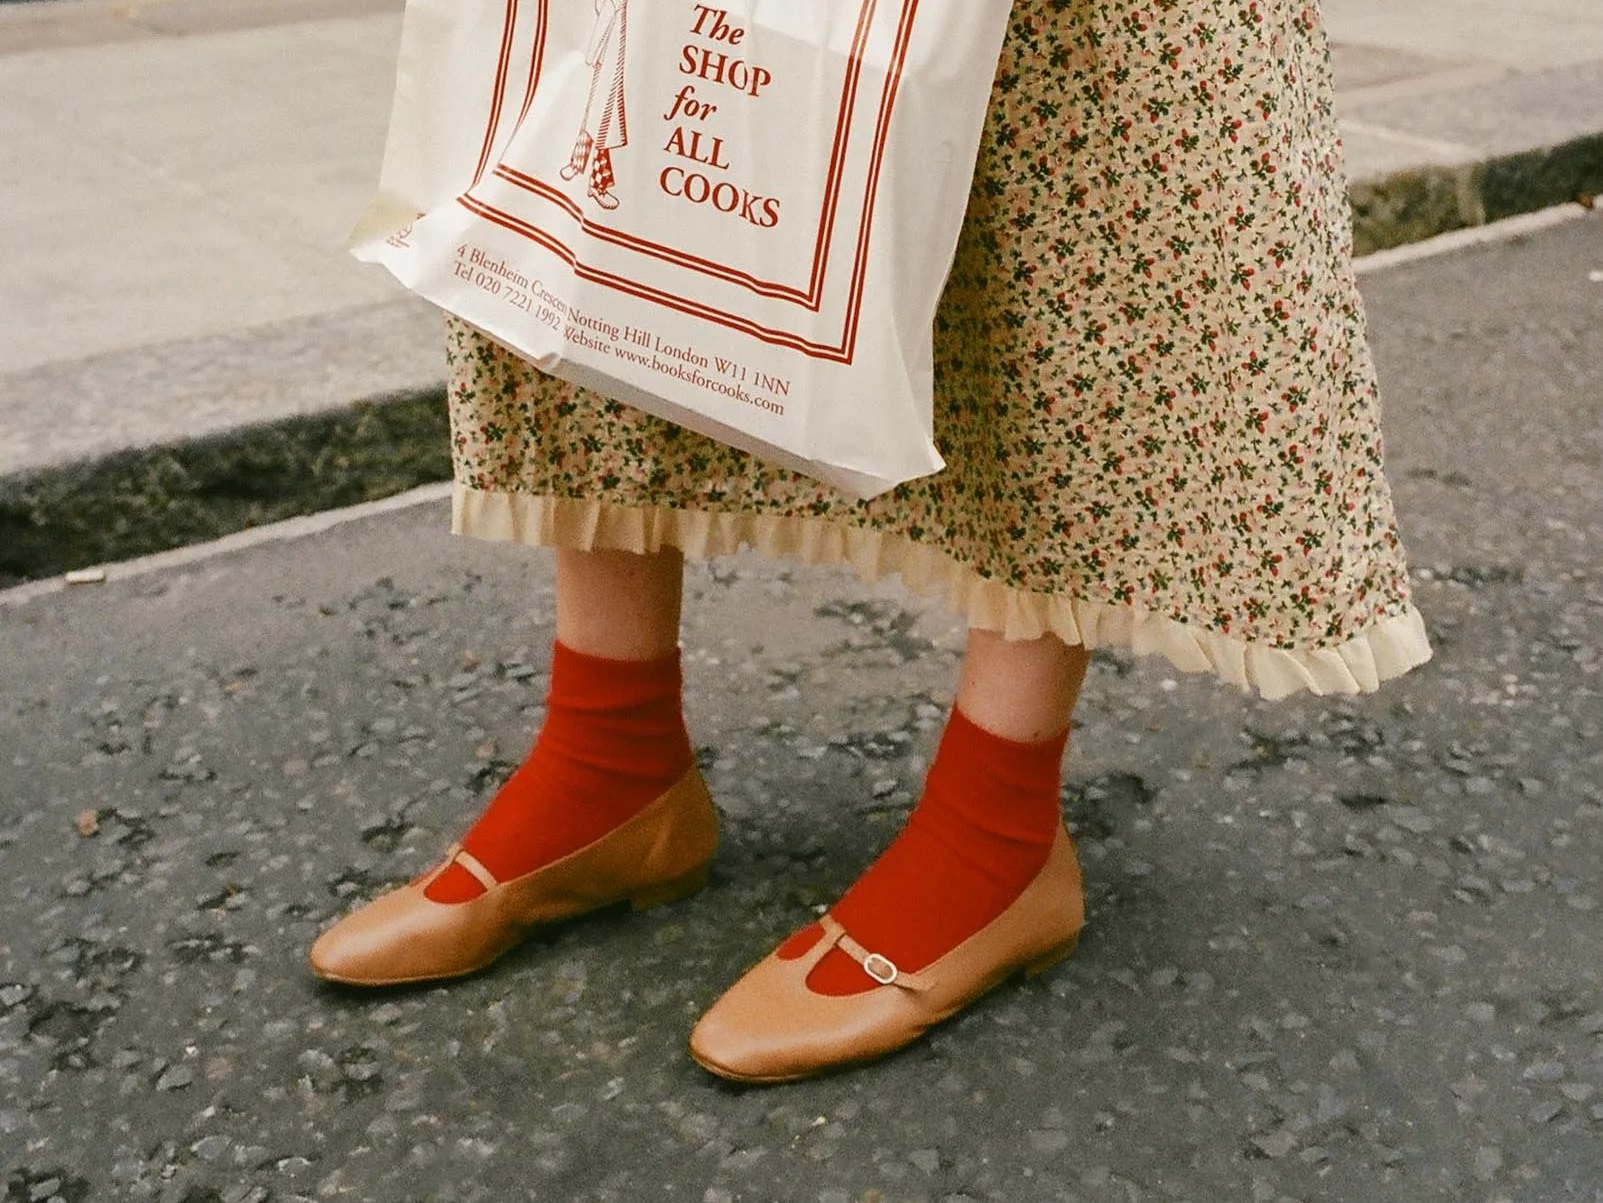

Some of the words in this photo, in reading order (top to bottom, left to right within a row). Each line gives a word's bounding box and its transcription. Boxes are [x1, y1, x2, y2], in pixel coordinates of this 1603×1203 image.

[689, 3, 745, 45] The
[679, 44, 772, 98] SHOP
[663, 85, 718, 121] for
[663, 126, 730, 170] ALL
[659, 166, 781, 228] COOKS
[454, 260, 475, 282] Tel
[475, 272, 501, 295] 020
[504, 286, 534, 313] 7221
[534, 304, 561, 331] 1992
[615, 346, 786, 416] www.booksforcooks.com
[456, 243, 467, 258] 4
[469, 247, 530, 290] Blenheim
[568, 306, 620, 342] Notting
[624, 326, 651, 348] Hill
[655, 336, 709, 369] London
[714, 356, 747, 382] W11
[753, 371, 792, 397] 1NN
